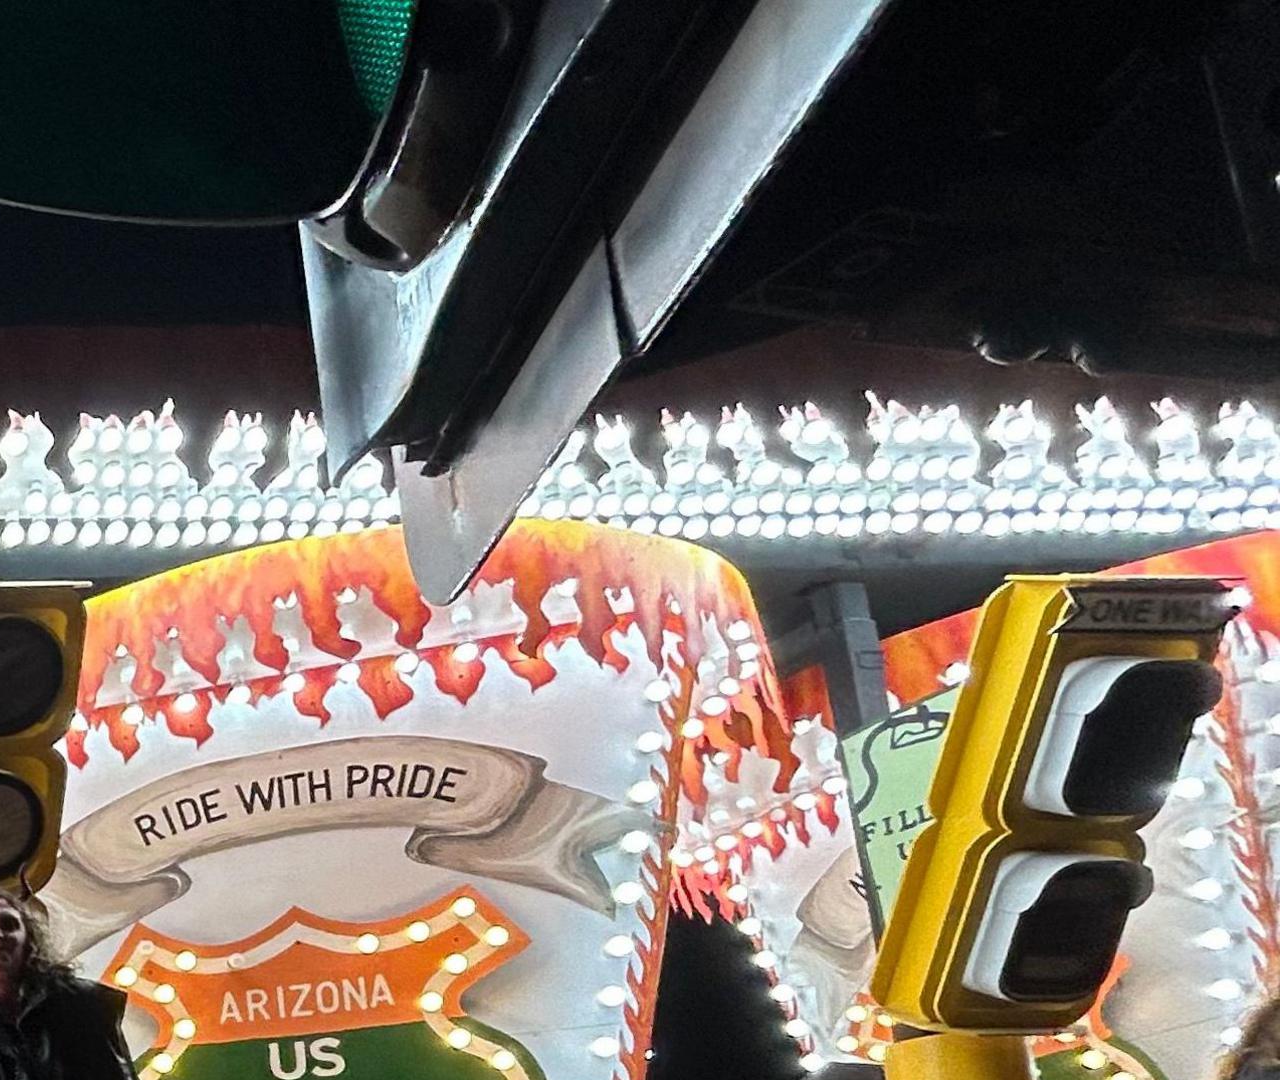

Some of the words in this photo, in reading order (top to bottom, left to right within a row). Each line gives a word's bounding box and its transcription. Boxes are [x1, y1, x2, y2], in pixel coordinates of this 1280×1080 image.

[134, 789, 228, 846] RIDE
[235, 768, 332, 815] WITH
[346, 763, 467, 803] PRIDE
[860, 804, 936, 842] FILL
[220, 974, 395, 1025] ARIZONA
[268, 1037, 346, 1080] US
